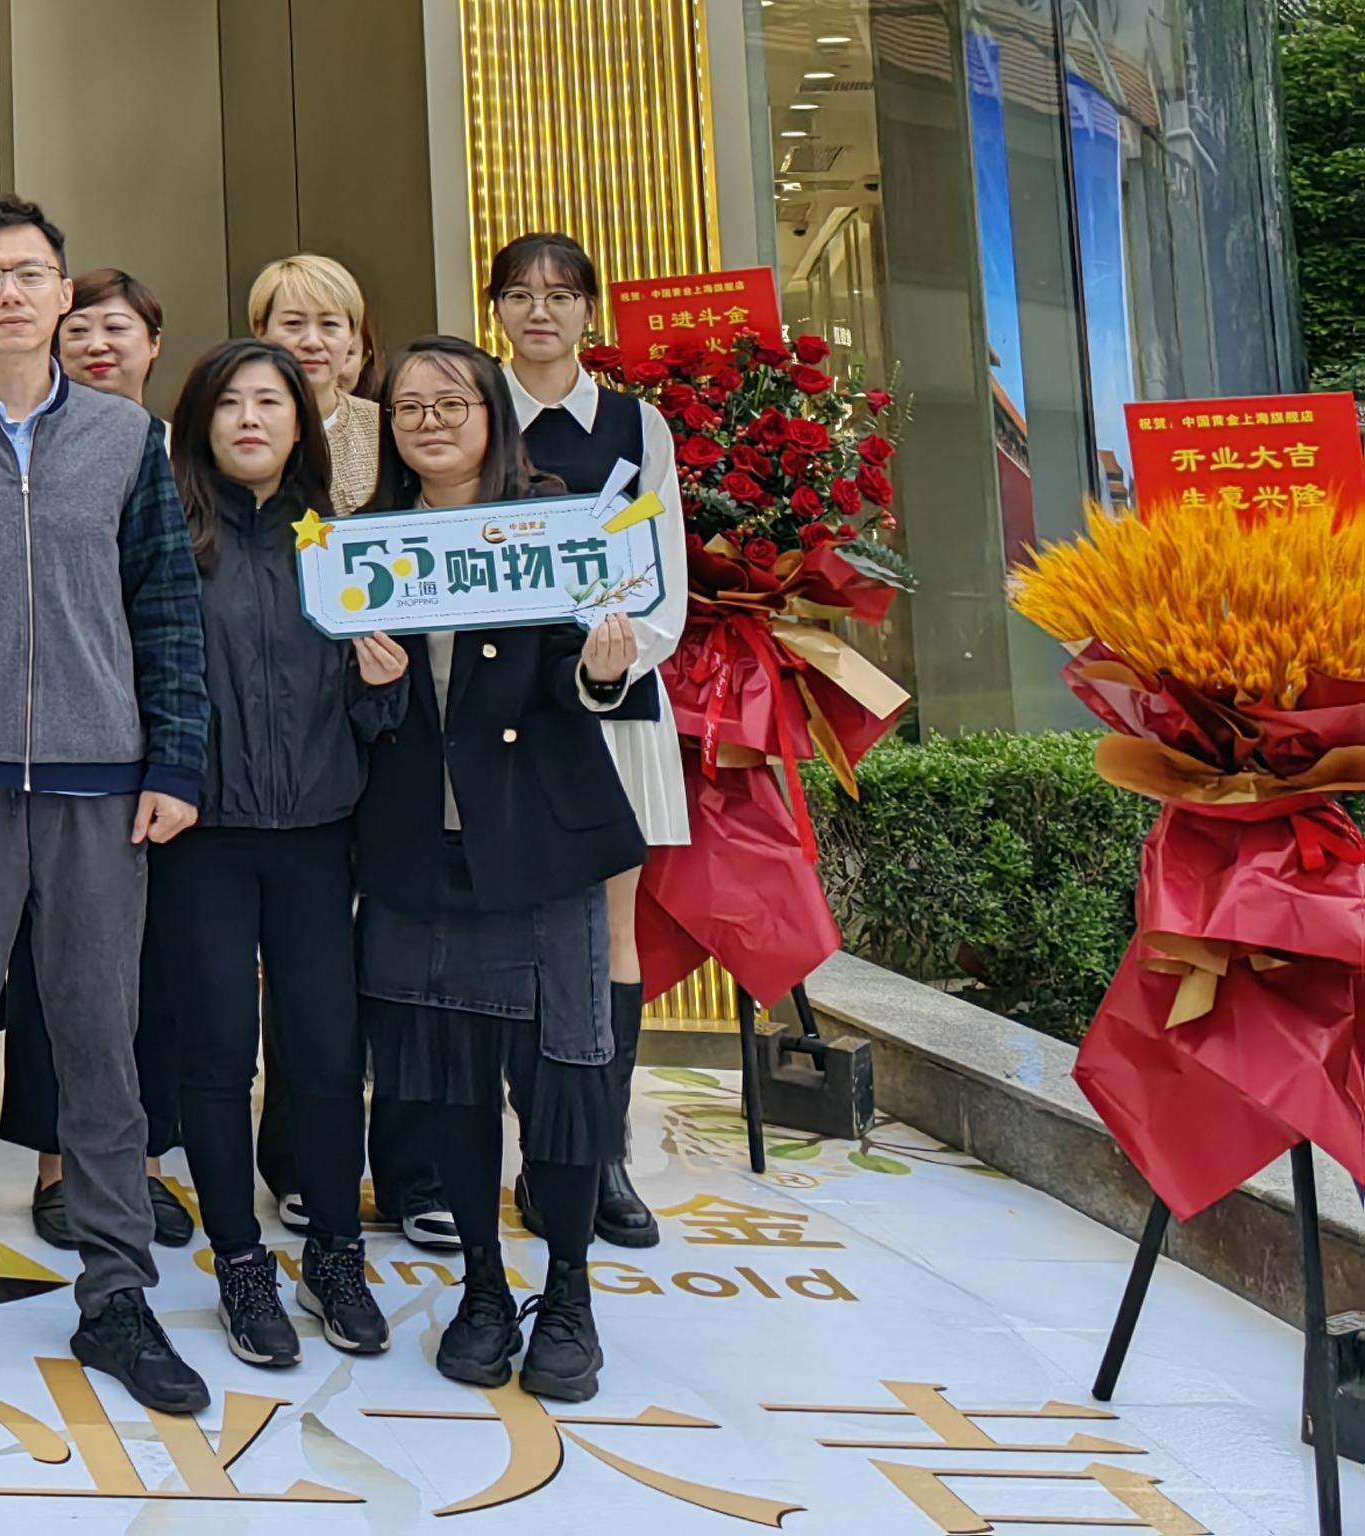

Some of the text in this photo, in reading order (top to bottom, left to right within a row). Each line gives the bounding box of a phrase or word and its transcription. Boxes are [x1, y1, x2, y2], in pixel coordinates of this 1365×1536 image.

[648, 305, 750, 331] 日进斗金
[1171, 441, 1320, 473] 开业大吉
[445, 537, 610, 595] 购物节
[396, 598, 439, 608] SHOPPING
[400, 581, 438, 597] 上海
[587, 1260, 861, 1302] Gold
